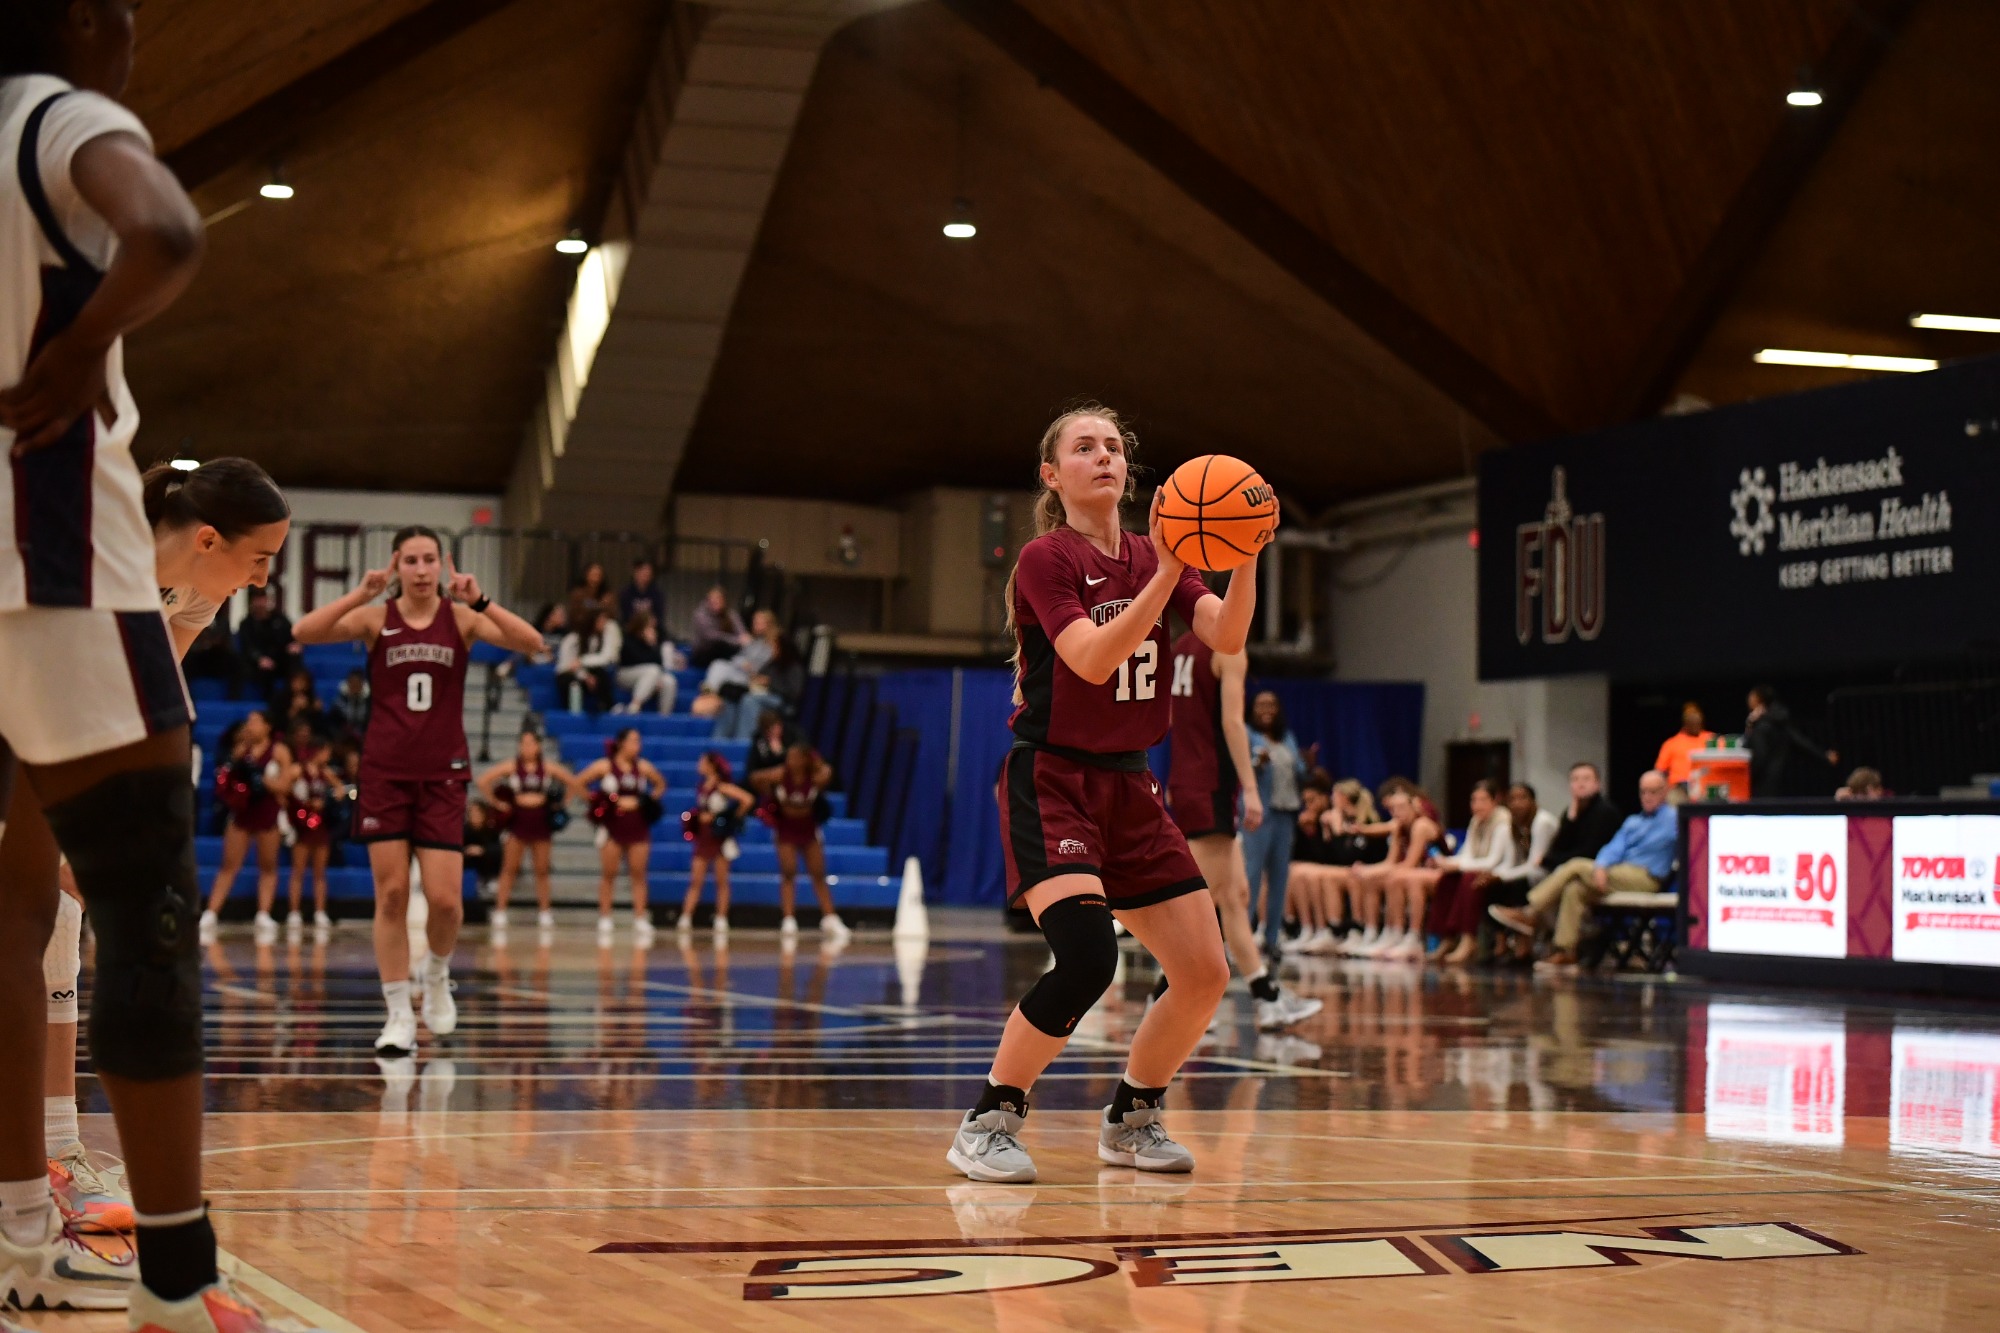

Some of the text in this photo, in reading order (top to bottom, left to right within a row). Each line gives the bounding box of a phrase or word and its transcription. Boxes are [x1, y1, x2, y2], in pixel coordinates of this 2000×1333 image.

[1779, 446, 1904, 501] Hackensack
[1242, 484, 1272, 508] Wil
[1778, 490, 1953, 551] Meridian Health
[1516, 512, 1606, 645] FDU
[1779, 545, 1954, 589] KEEP GETTING BETTER
[407, 672, 433, 712] 0
[1115, 639, 1158, 702] 12
[1171, 654, 1195, 697] 14
[1718, 855, 1770, 875] TOYOTA
[1795, 853, 1838, 901] 50
[1902, 857, 1966, 879] TOYOTA
[1717, 884, 1788, 900] Hackensack
[1902, 889, 1986, 905] Hackensack
